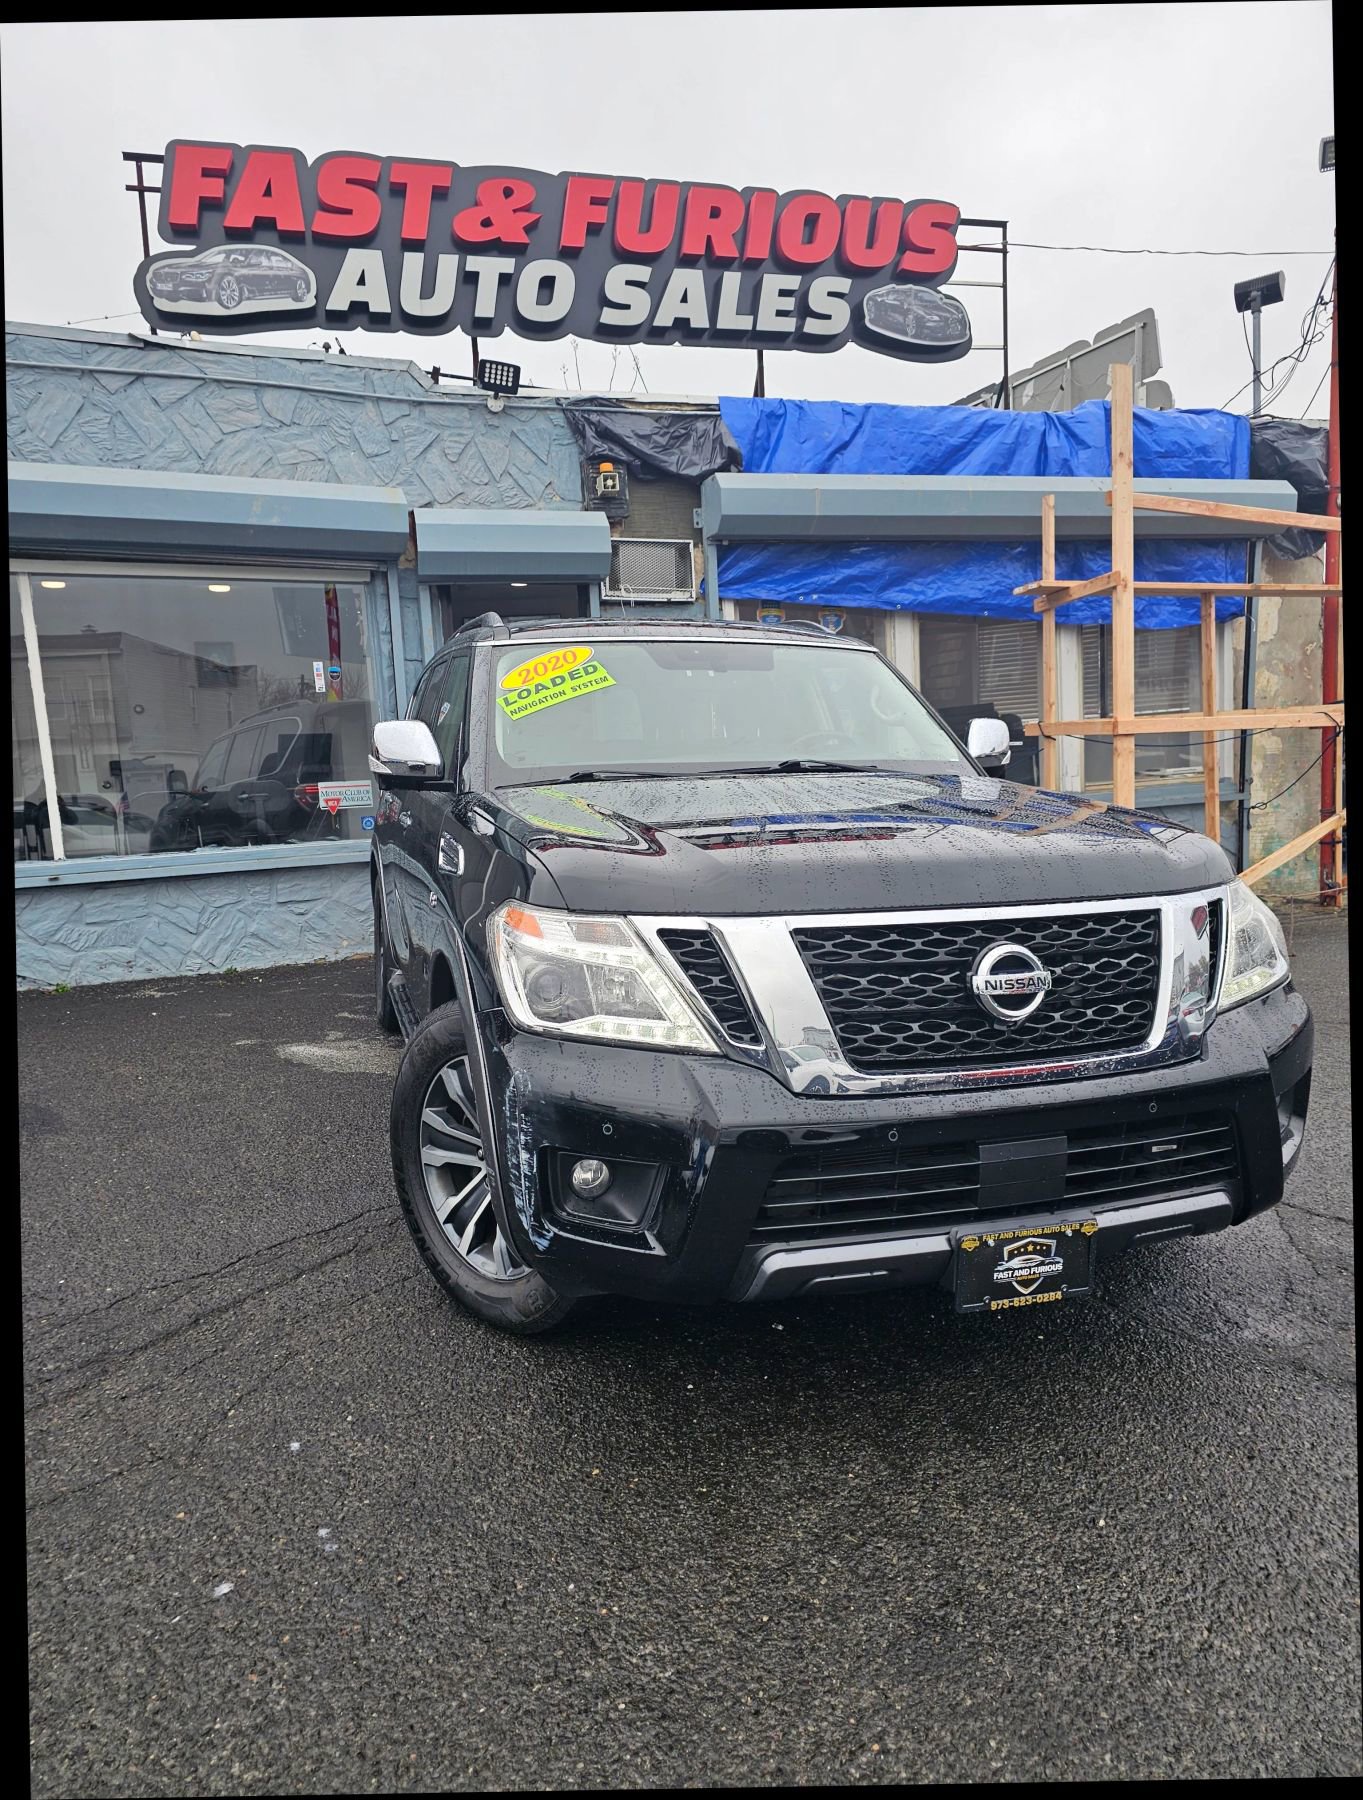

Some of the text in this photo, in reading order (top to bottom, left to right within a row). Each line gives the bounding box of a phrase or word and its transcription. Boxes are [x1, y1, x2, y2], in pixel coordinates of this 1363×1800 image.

[167, 144, 962, 275] FAST & FURIOUS
[324, 248, 852, 337] AUTO SALES
[502, 664, 598, 707] LOADED
[518, 650, 577, 685] 2020
[510, 676, 609, 717] NAVIGATION SYSTEM
[984, 976, 1047, 991] NISSAN
[1014, 1229, 1043, 1238] FURIOUS
[1043, 1226, 1060, 1234] AUTO
[1061, 1224, 1080, 1232] SALES
[993, 1263, 1062, 1280] FAST AND FURIOUS
